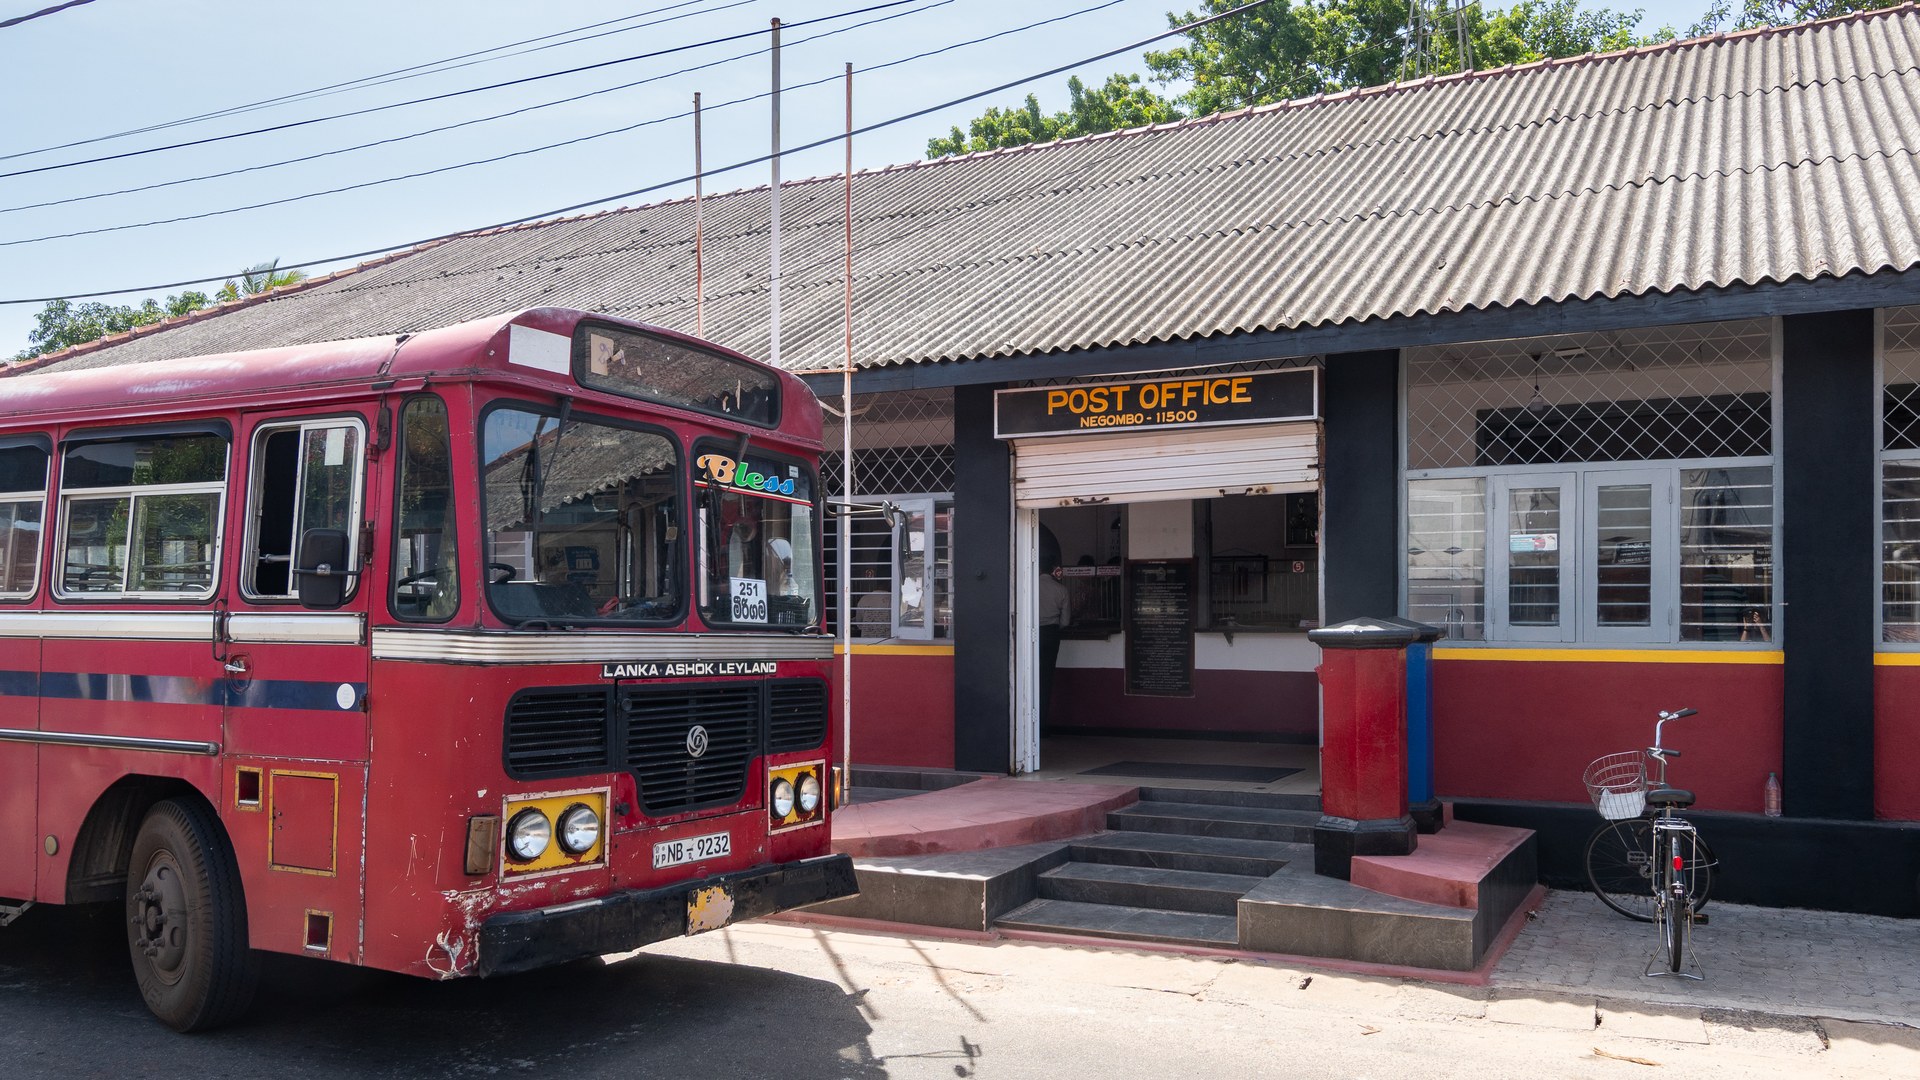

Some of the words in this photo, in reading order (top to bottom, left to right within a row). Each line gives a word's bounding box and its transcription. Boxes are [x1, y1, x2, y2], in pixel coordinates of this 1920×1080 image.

[1047, 385, 1131, 415] POST
[1139, 377, 1253, 409] OFFICE
[1080, 413, 1144, 428] NEGOMBO
[1156, 410, 1198, 423] 11500
[696, 454, 795, 495] Bless
[739, 582, 758, 596] 251
[603, 664, 659, 677] LANKA
[665, 663, 714, 675] ASHOK
[719, 662, 777, 674] LEYLAND
[667, 843, 683, 863] NB
[697, 835, 729, 857] 9232
